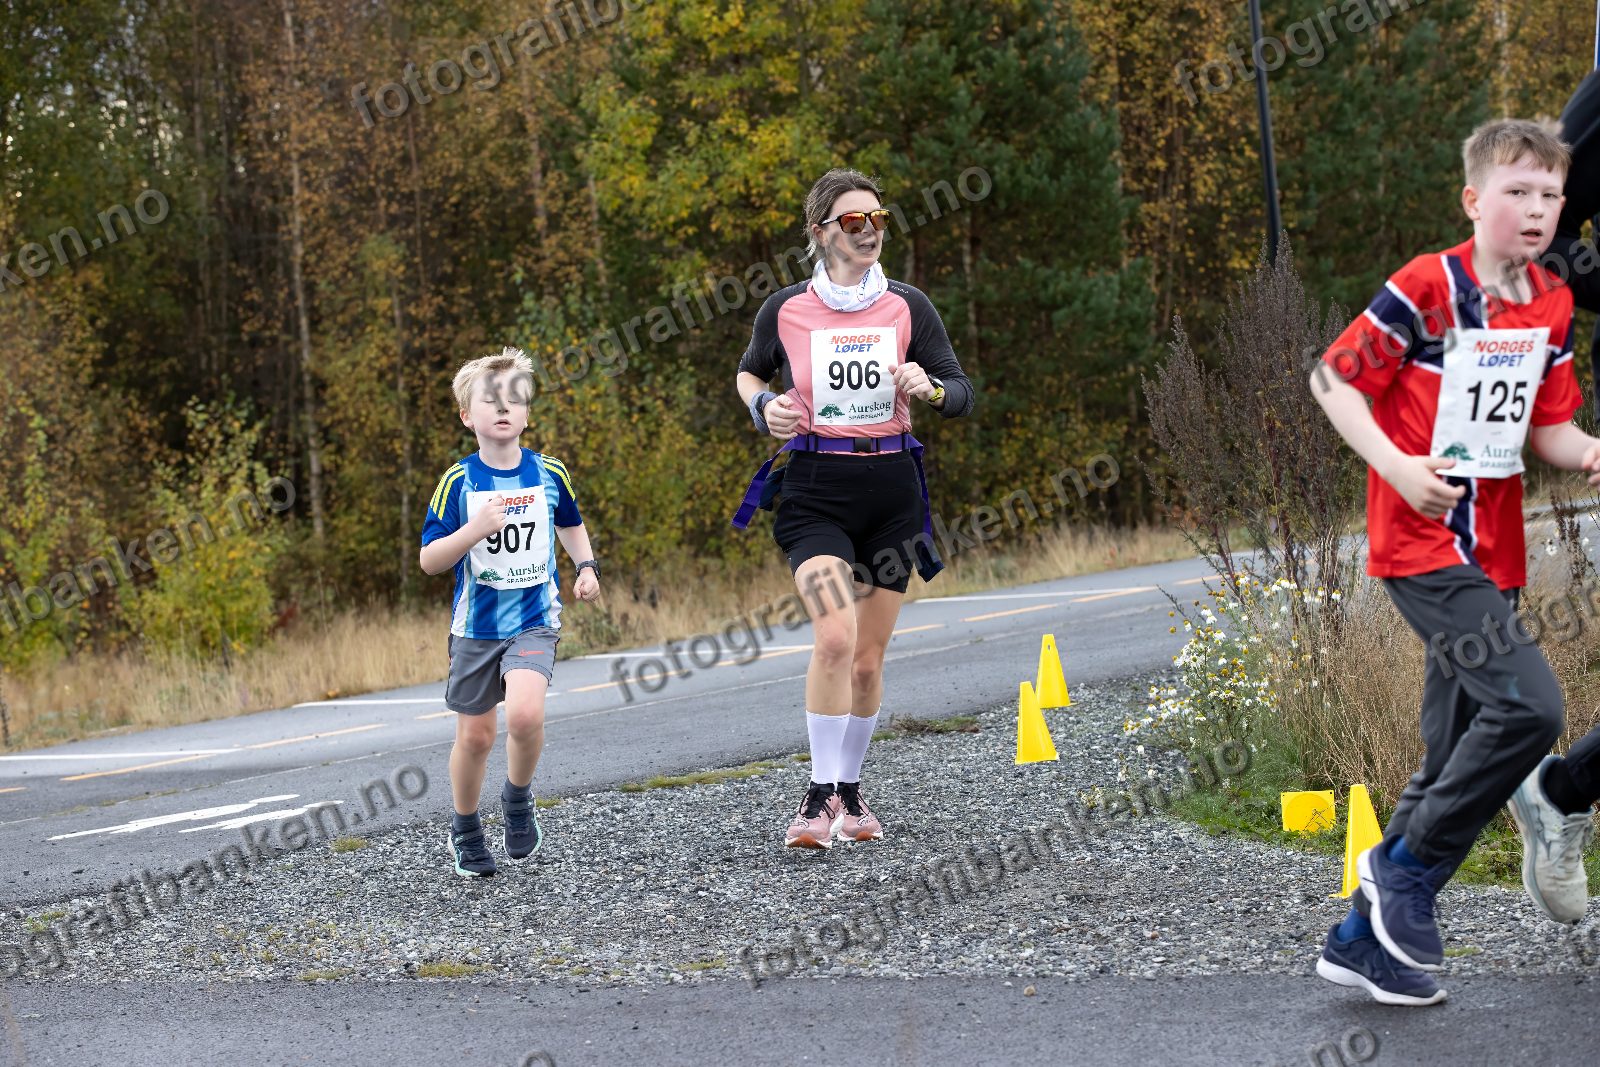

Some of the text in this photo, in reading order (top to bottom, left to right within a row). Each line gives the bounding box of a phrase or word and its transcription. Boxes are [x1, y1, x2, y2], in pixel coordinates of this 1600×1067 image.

[830, 334, 881, 345] NORGES
[834, 343, 873, 353] LØPET
[1473, 340, 1535, 353] NORGES
[1477, 354, 1525, 367] LØPET
[828, 360, 881, 391] 906
[848, 401, 892, 413] Aurskog
[1467, 380, 1528, 423] 125
[489, 494, 535, 506] RGES
[503, 505, 528, 516] PET
[486, 522, 536, 555] 907
